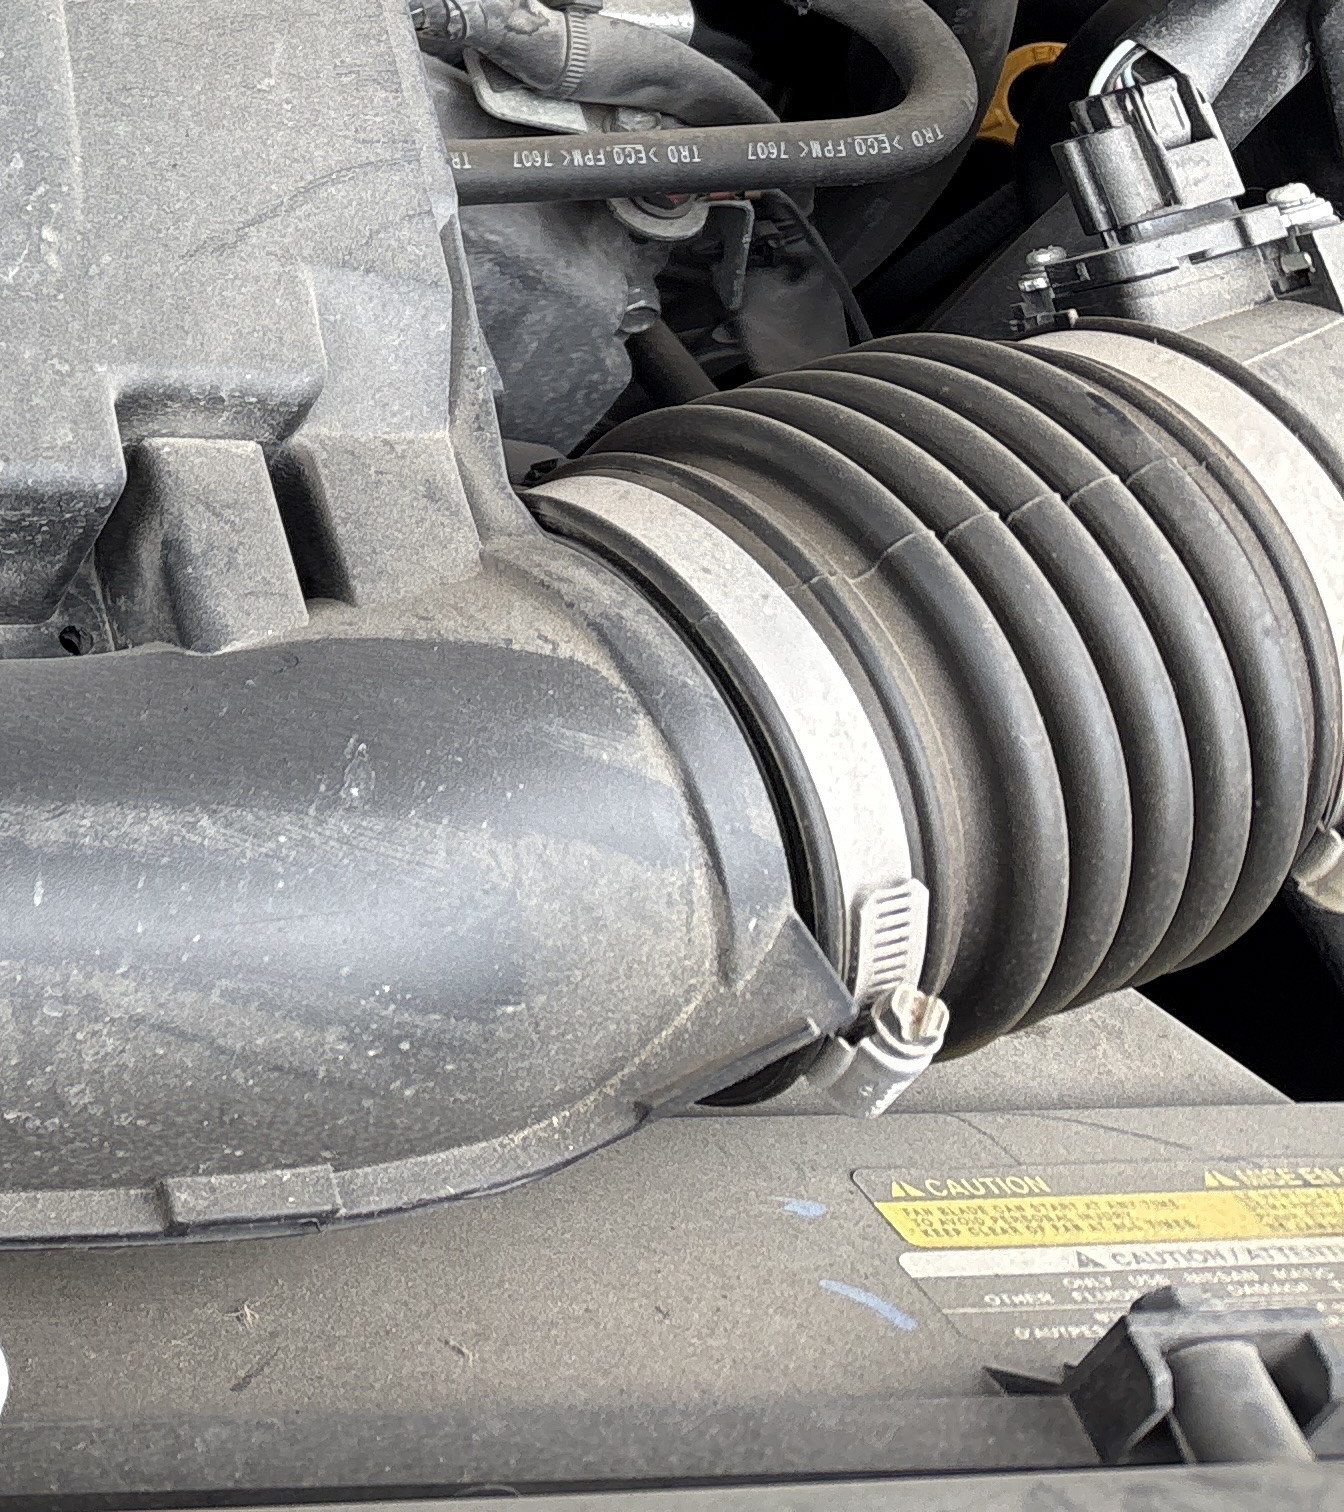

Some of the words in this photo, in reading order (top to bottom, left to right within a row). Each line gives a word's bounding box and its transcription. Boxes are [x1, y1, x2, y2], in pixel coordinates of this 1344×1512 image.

[912, 124, 945, 148] TRO
[513, 150, 553, 168] 7607
[668, 145, 702, 163] TRO
[747, 141, 789, 160] 7607
[449, 152, 472, 169] TR
[924, 1176, 1052, 1197] CAUTION
[1112, 1248, 1230, 1267] CAUTION
